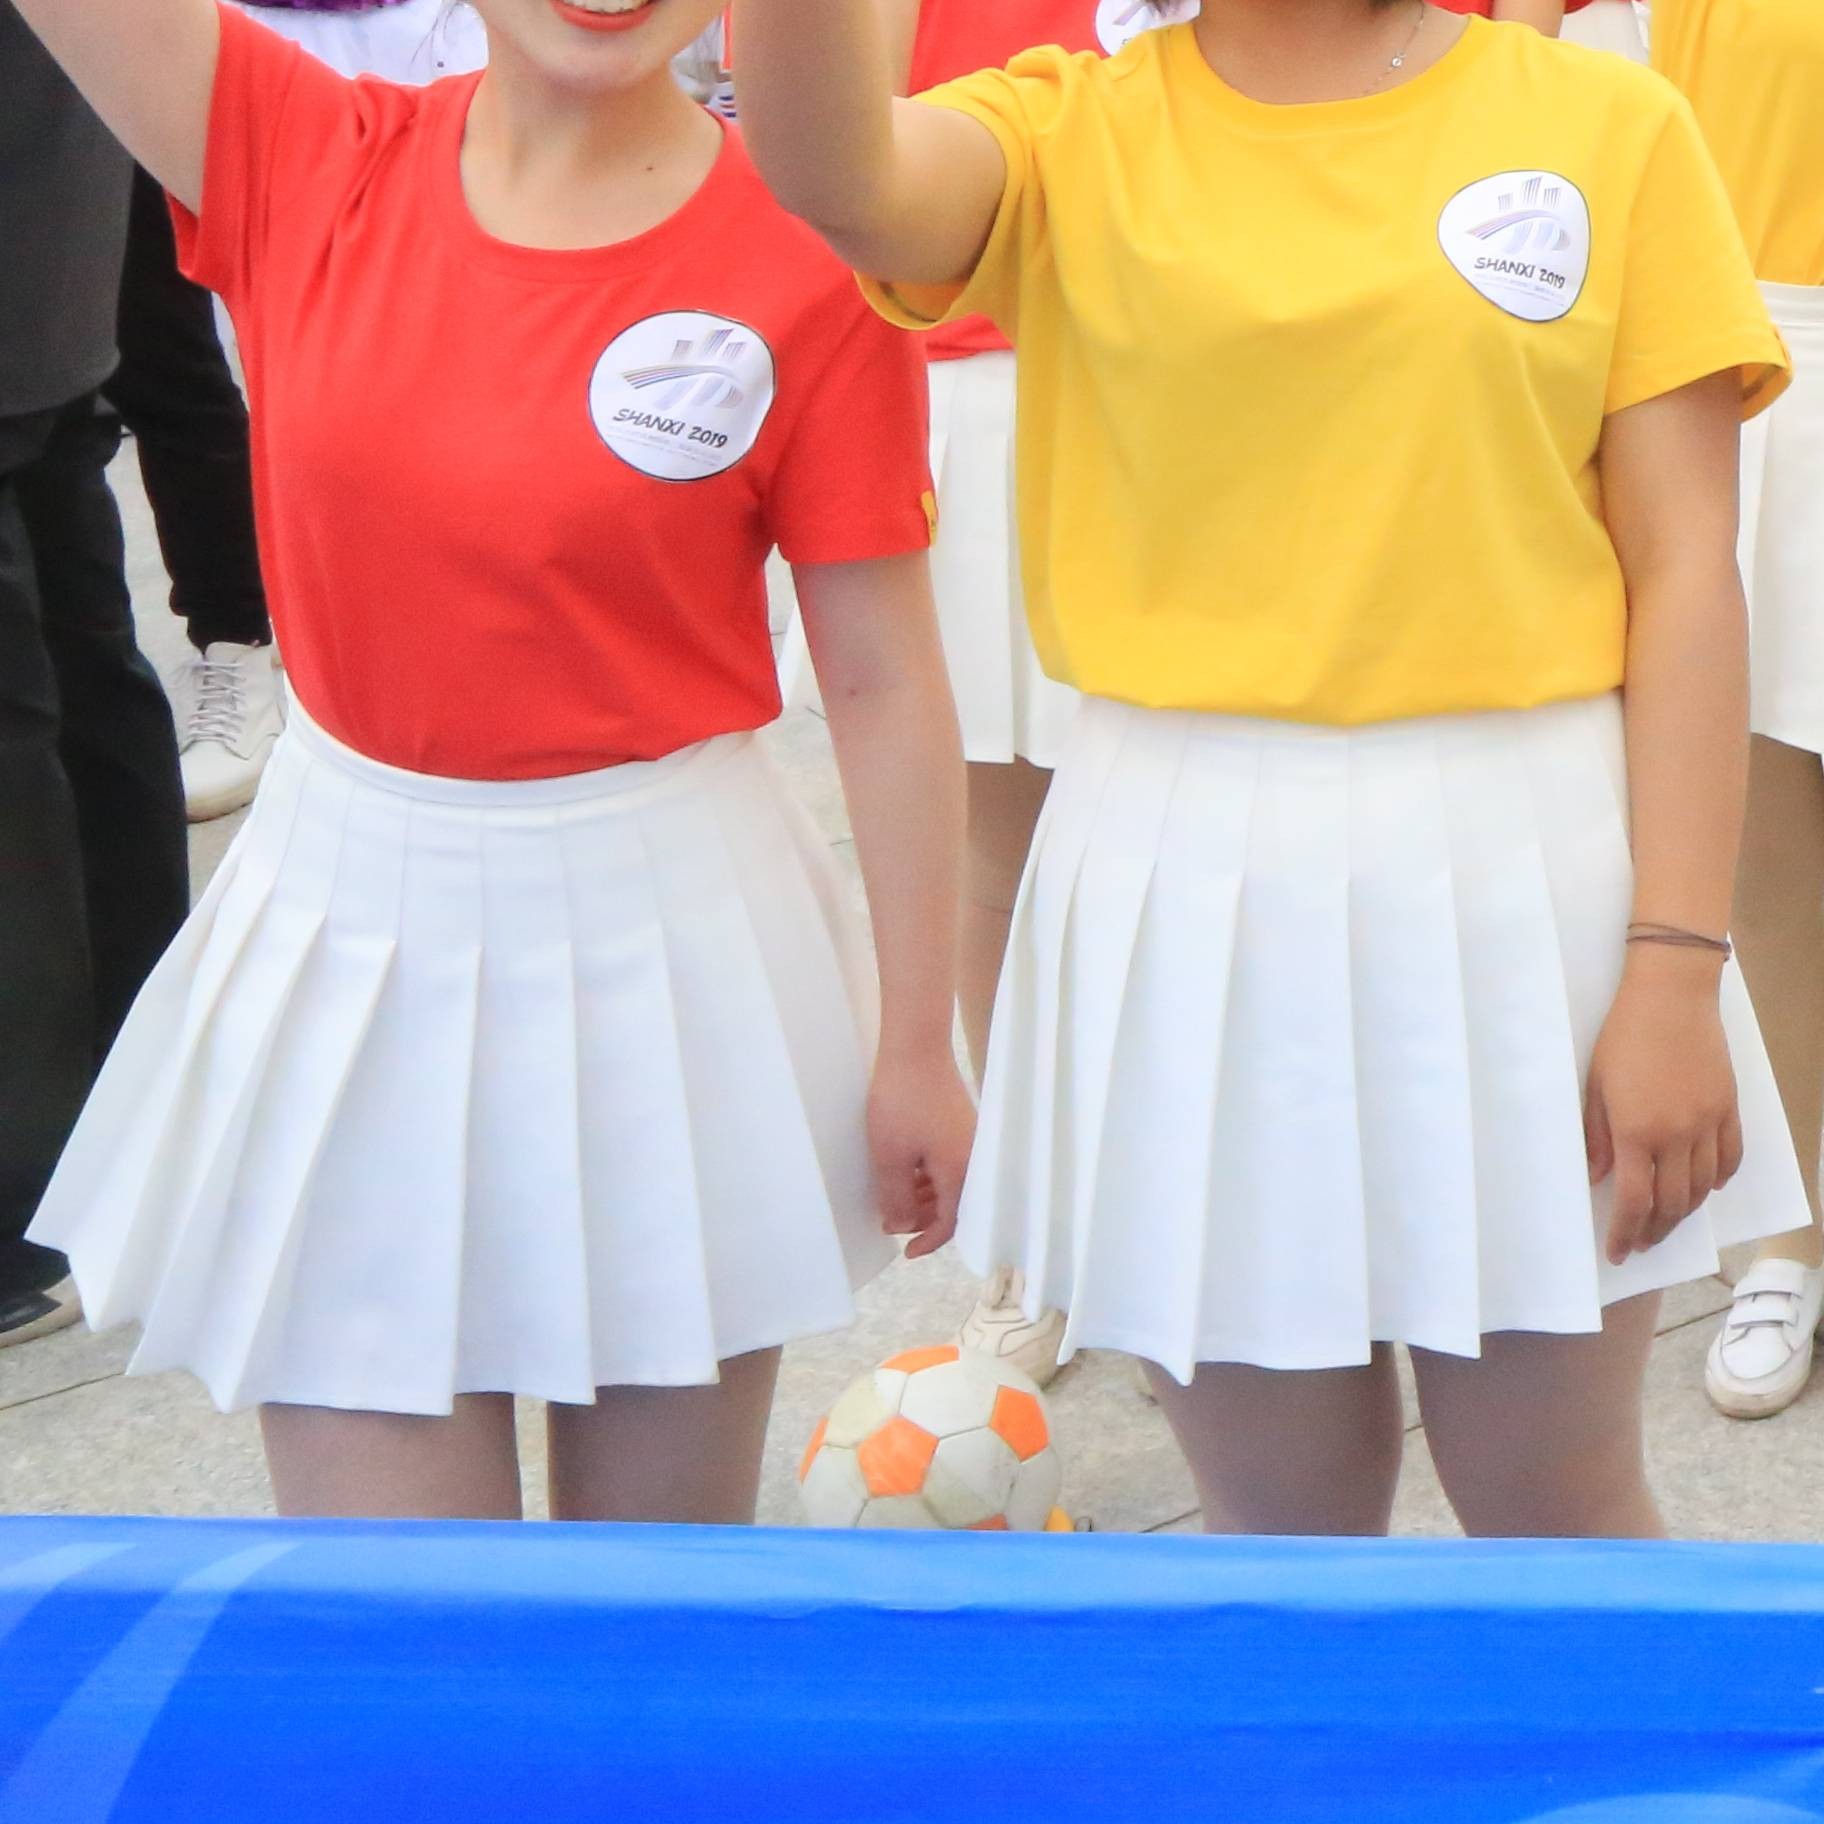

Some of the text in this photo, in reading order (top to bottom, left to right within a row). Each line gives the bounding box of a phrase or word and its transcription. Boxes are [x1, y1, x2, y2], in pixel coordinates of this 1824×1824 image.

[1474, 256, 1566, 289] SHANXI 2019
[612, 408, 685, 437] SHANXI
[687, 426, 729, 449] 2019
